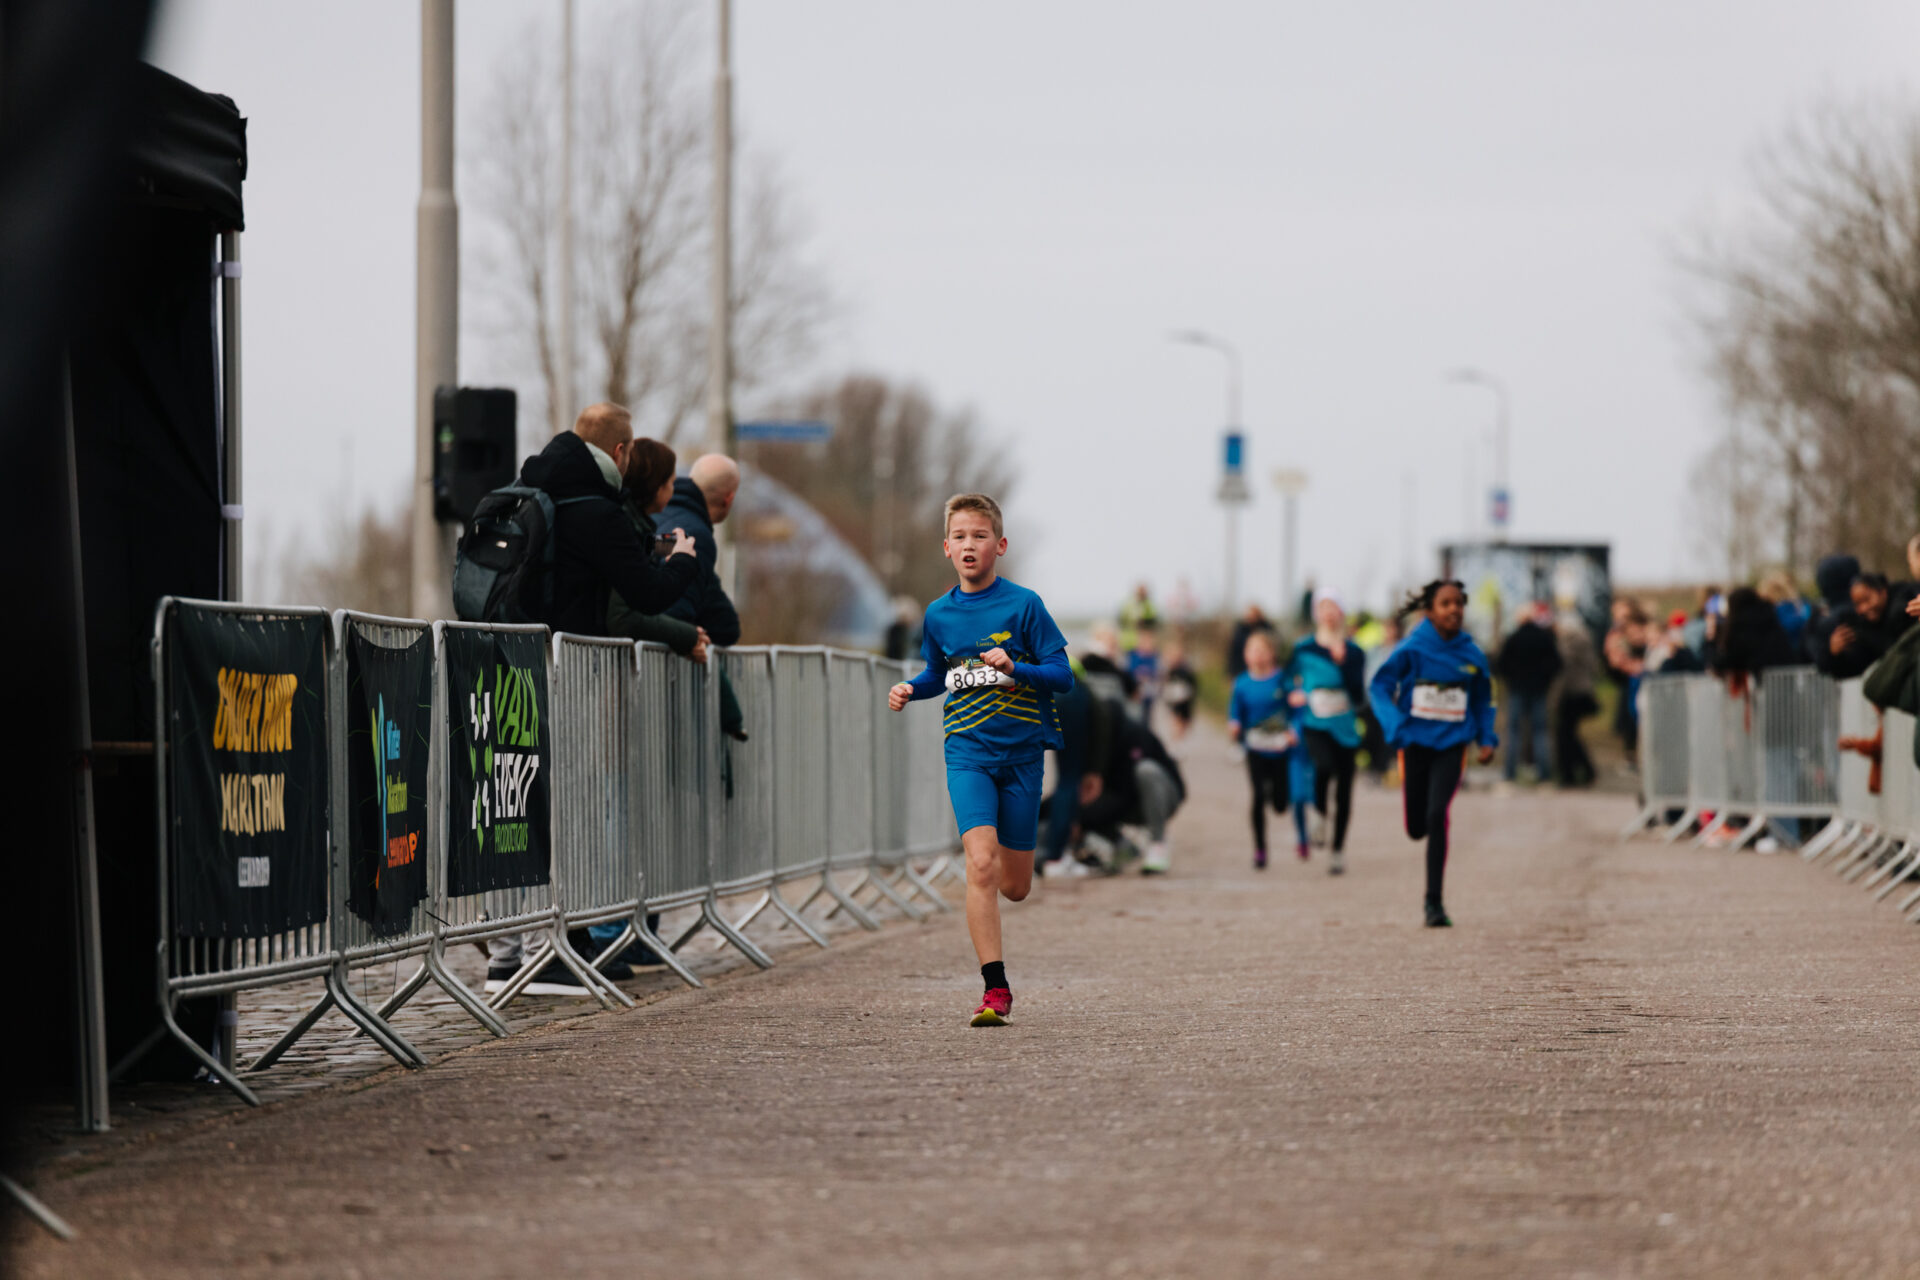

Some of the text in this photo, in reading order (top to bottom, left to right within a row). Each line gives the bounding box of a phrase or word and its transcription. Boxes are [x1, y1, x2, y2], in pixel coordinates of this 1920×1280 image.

[494, 664, 540, 747] VALK
[953, 670, 998, 689] 8033
[220, 772, 285, 837] MARATHON
[494, 752, 540, 819] EVENT
